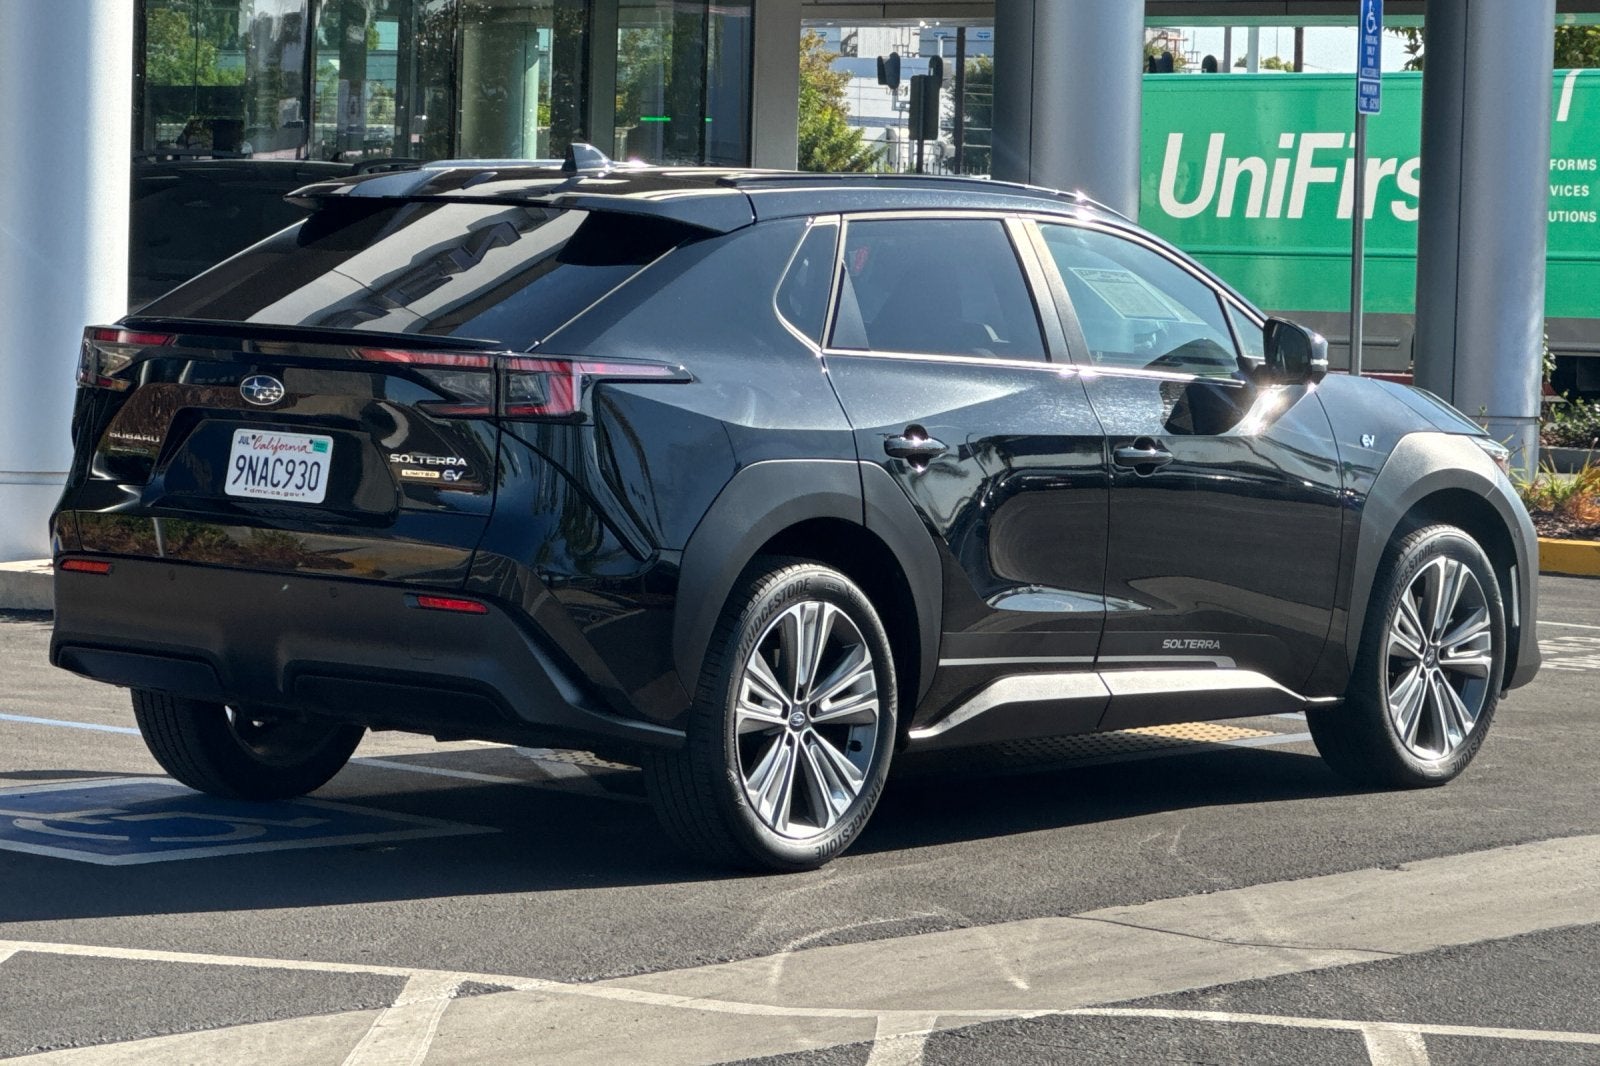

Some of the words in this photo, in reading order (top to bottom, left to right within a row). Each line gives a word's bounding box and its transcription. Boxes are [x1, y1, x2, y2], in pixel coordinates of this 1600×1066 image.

[1549, 159, 1597, 171] FORMS
[1550, 185, 1590, 197] VICES
[1548, 211, 1597, 223] UTIONS
[109, 432, 161, 443] SUBARU
[238, 435, 250, 446] JUL
[252, 434, 312, 456] California
[390, 453, 468, 467] SOLTERRA
[232, 454, 321, 492] 9NAC930
[442, 469, 464, 482] EV
[249, 487, 300, 498] dmv.ca.gov
[1162, 638, 1221, 650] SOLTERRA
